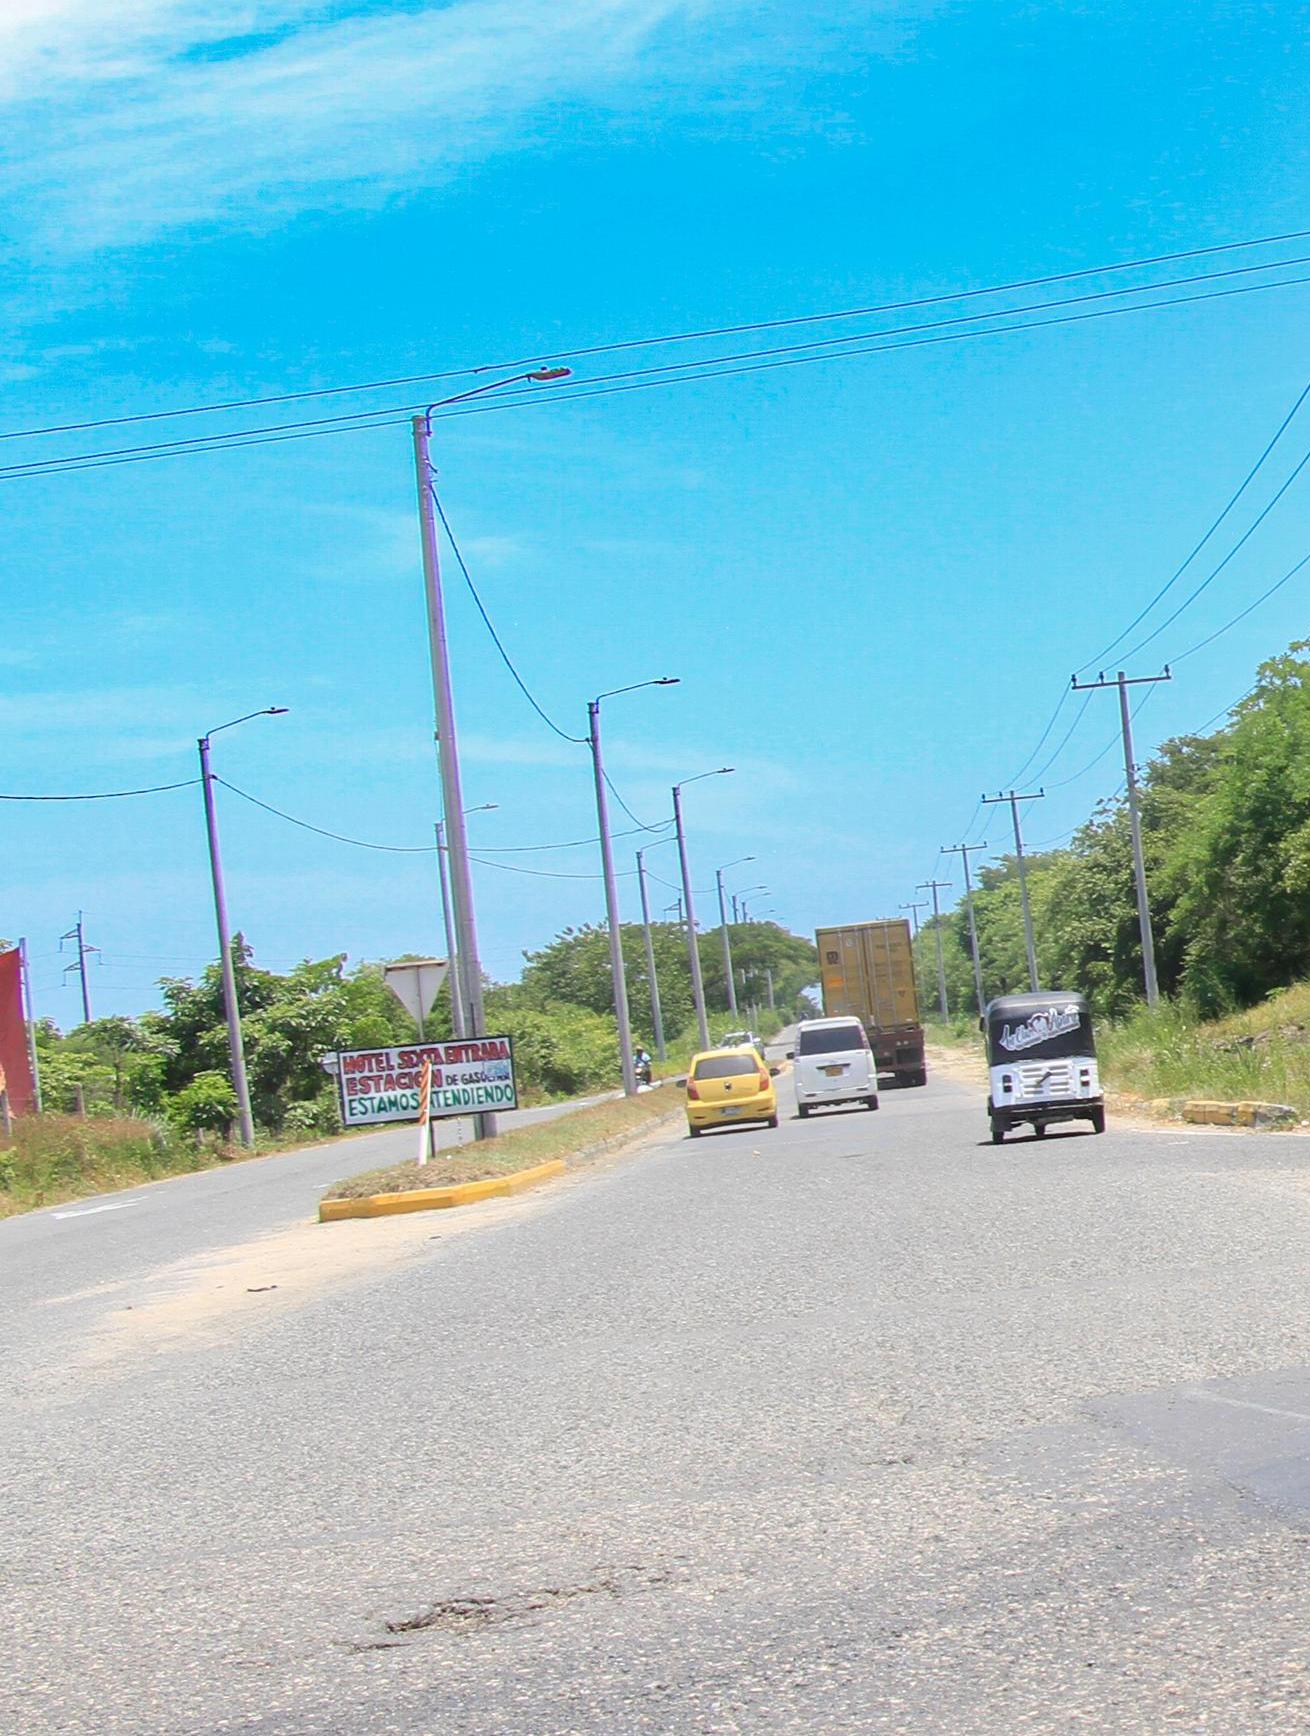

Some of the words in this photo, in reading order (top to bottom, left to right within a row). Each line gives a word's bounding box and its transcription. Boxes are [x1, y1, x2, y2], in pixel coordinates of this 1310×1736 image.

[341, 1052, 395, 1075] HOTEL
[446, 1074, 458, 1086] DE
[350, 1095, 420, 1116] ESTAMOS
